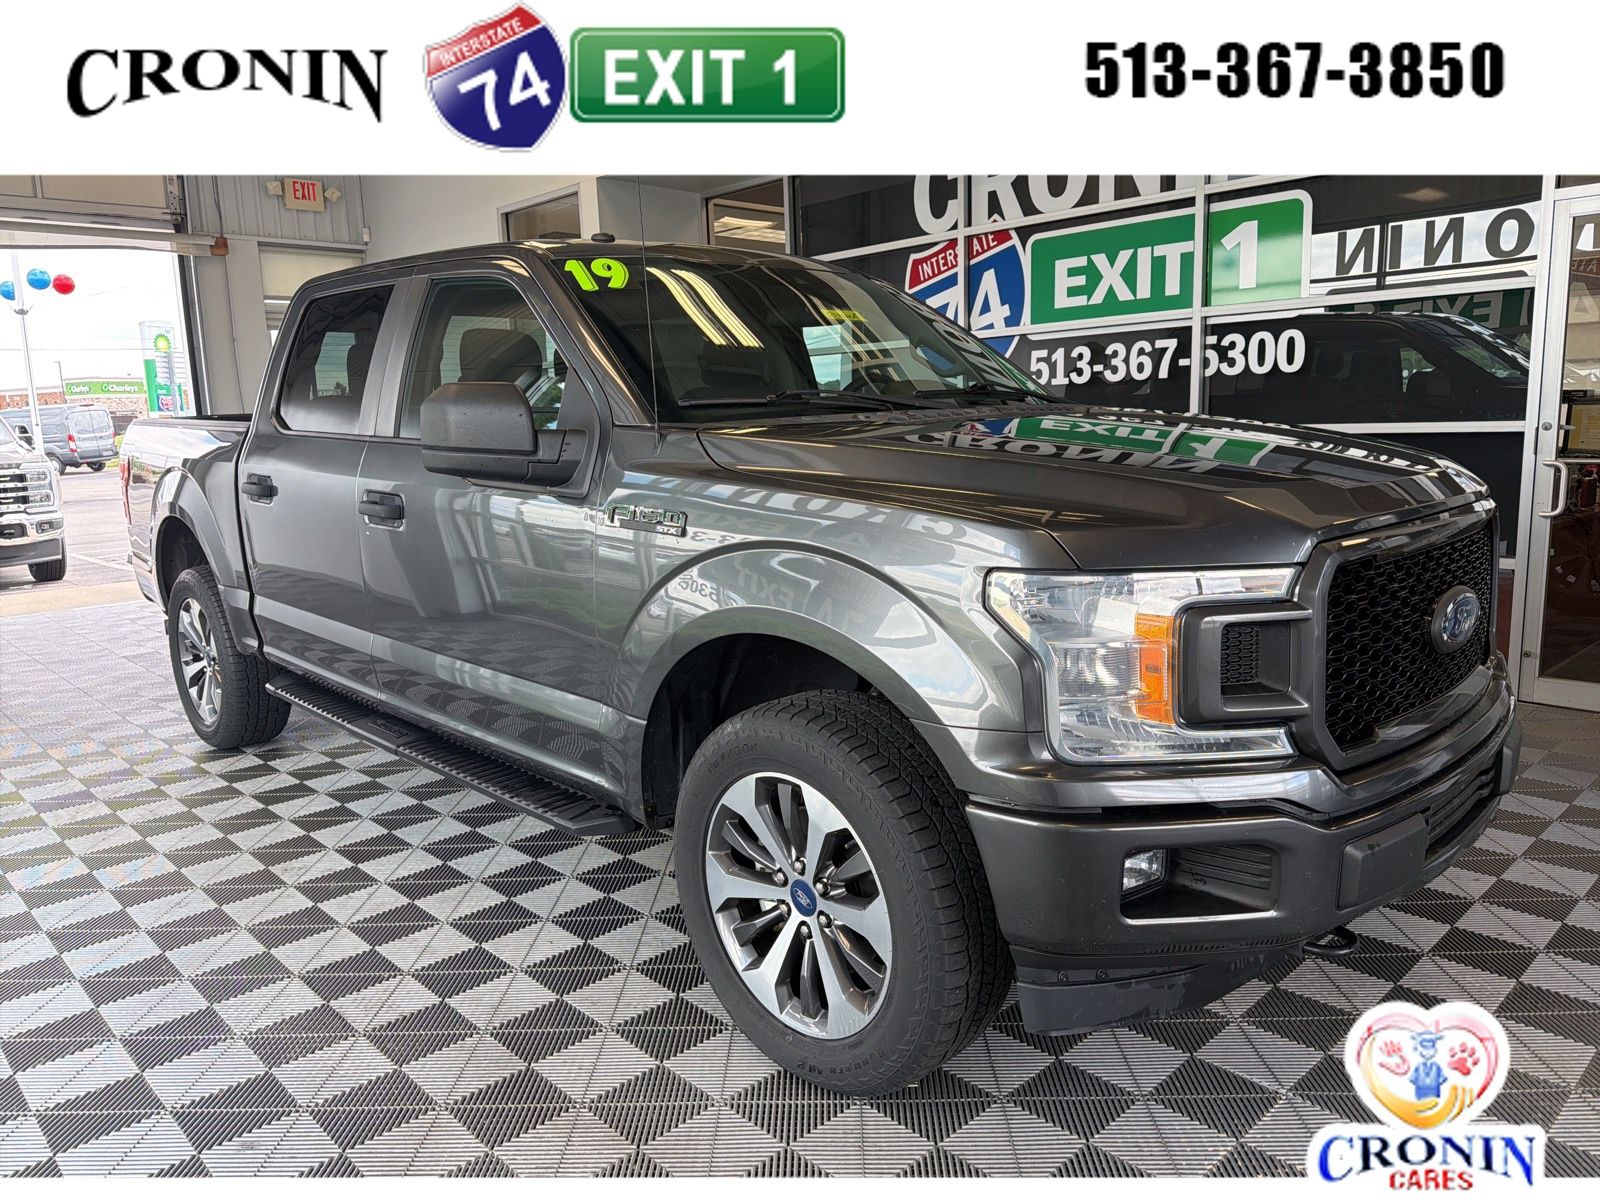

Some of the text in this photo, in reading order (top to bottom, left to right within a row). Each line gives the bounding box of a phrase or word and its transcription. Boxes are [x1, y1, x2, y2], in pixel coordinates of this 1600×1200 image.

[292, 180, 318, 202] EXIT
[564, 258, 630, 292] 19
[918, 234, 998, 281] INTERATE
[1054, 220, 1259, 309] EXIT 1
[1029, 328, 1306, 386] 513-367-5300
[656, 524, 677, 535] STX
